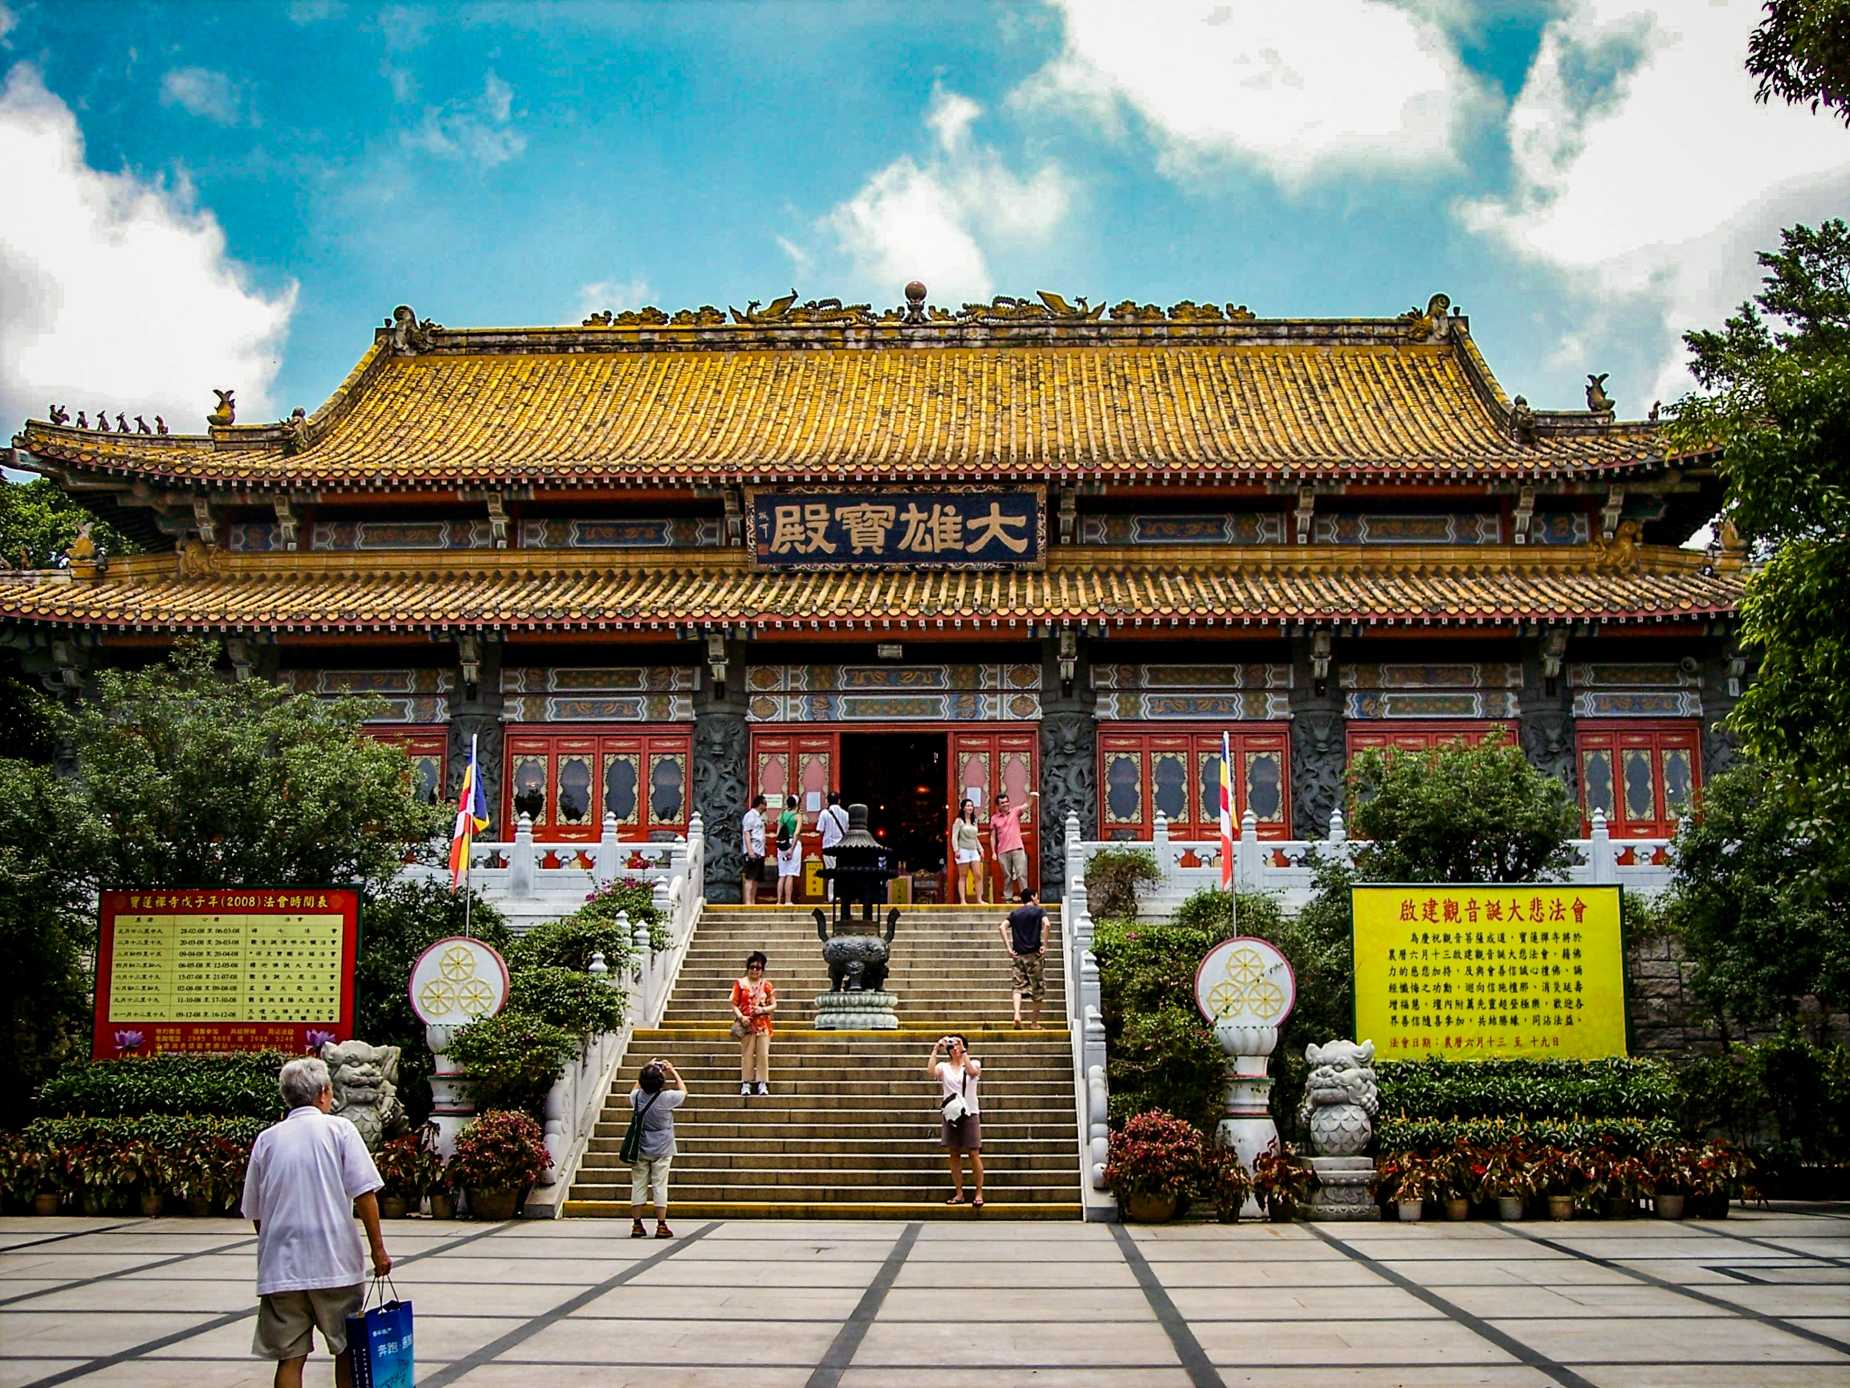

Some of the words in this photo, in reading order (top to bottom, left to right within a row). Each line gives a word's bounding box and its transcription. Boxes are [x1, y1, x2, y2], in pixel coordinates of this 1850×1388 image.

[770, 502, 1029, 555] 大雄寶殿
[1399, 896, 1588, 924] 啟建觀音誕大悲法會
